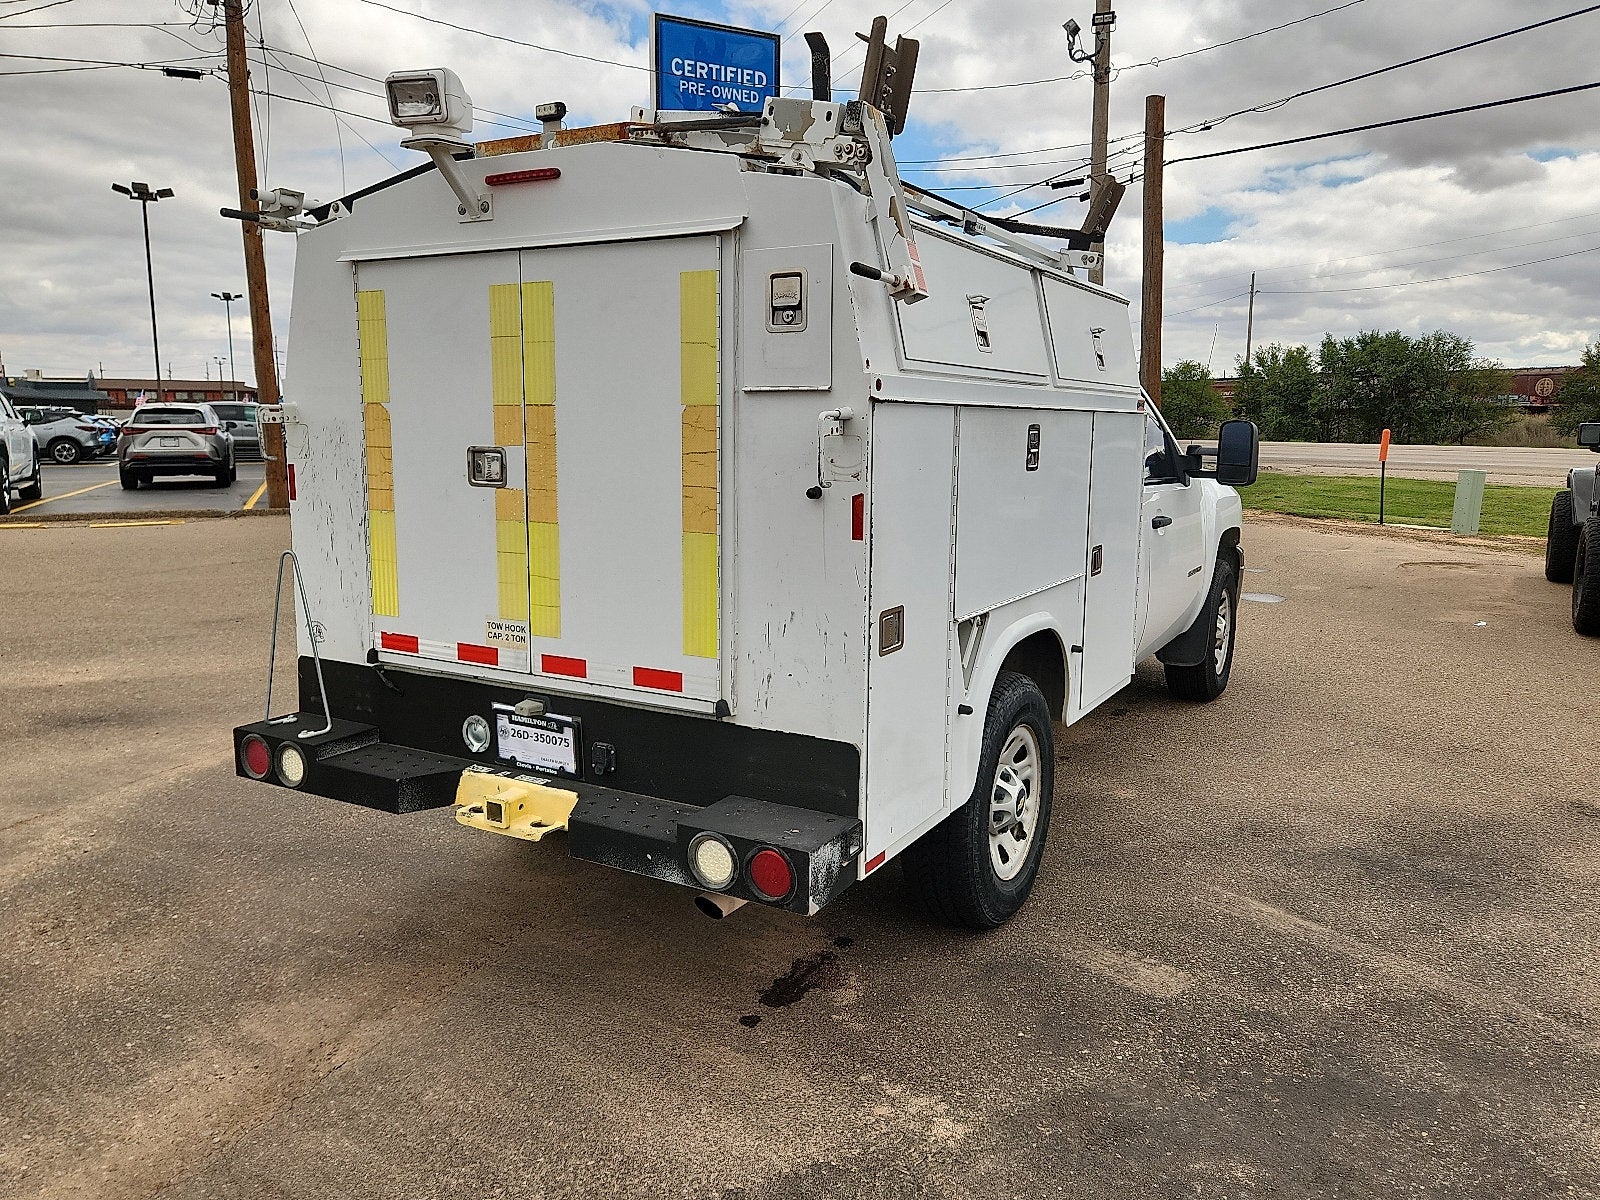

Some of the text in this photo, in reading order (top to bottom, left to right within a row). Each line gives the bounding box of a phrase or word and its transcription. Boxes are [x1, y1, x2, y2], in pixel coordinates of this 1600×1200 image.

[671, 57, 767, 88] CERTIFIED
[680, 80, 759, 104] PRE-OWNED
[487, 621, 526, 634] TOW HOOK
[487, 631, 526, 643] CAP. 2 TON
[511, 714, 547, 727] HAMILTON
[510, 728, 570, 748] 26D-350075
